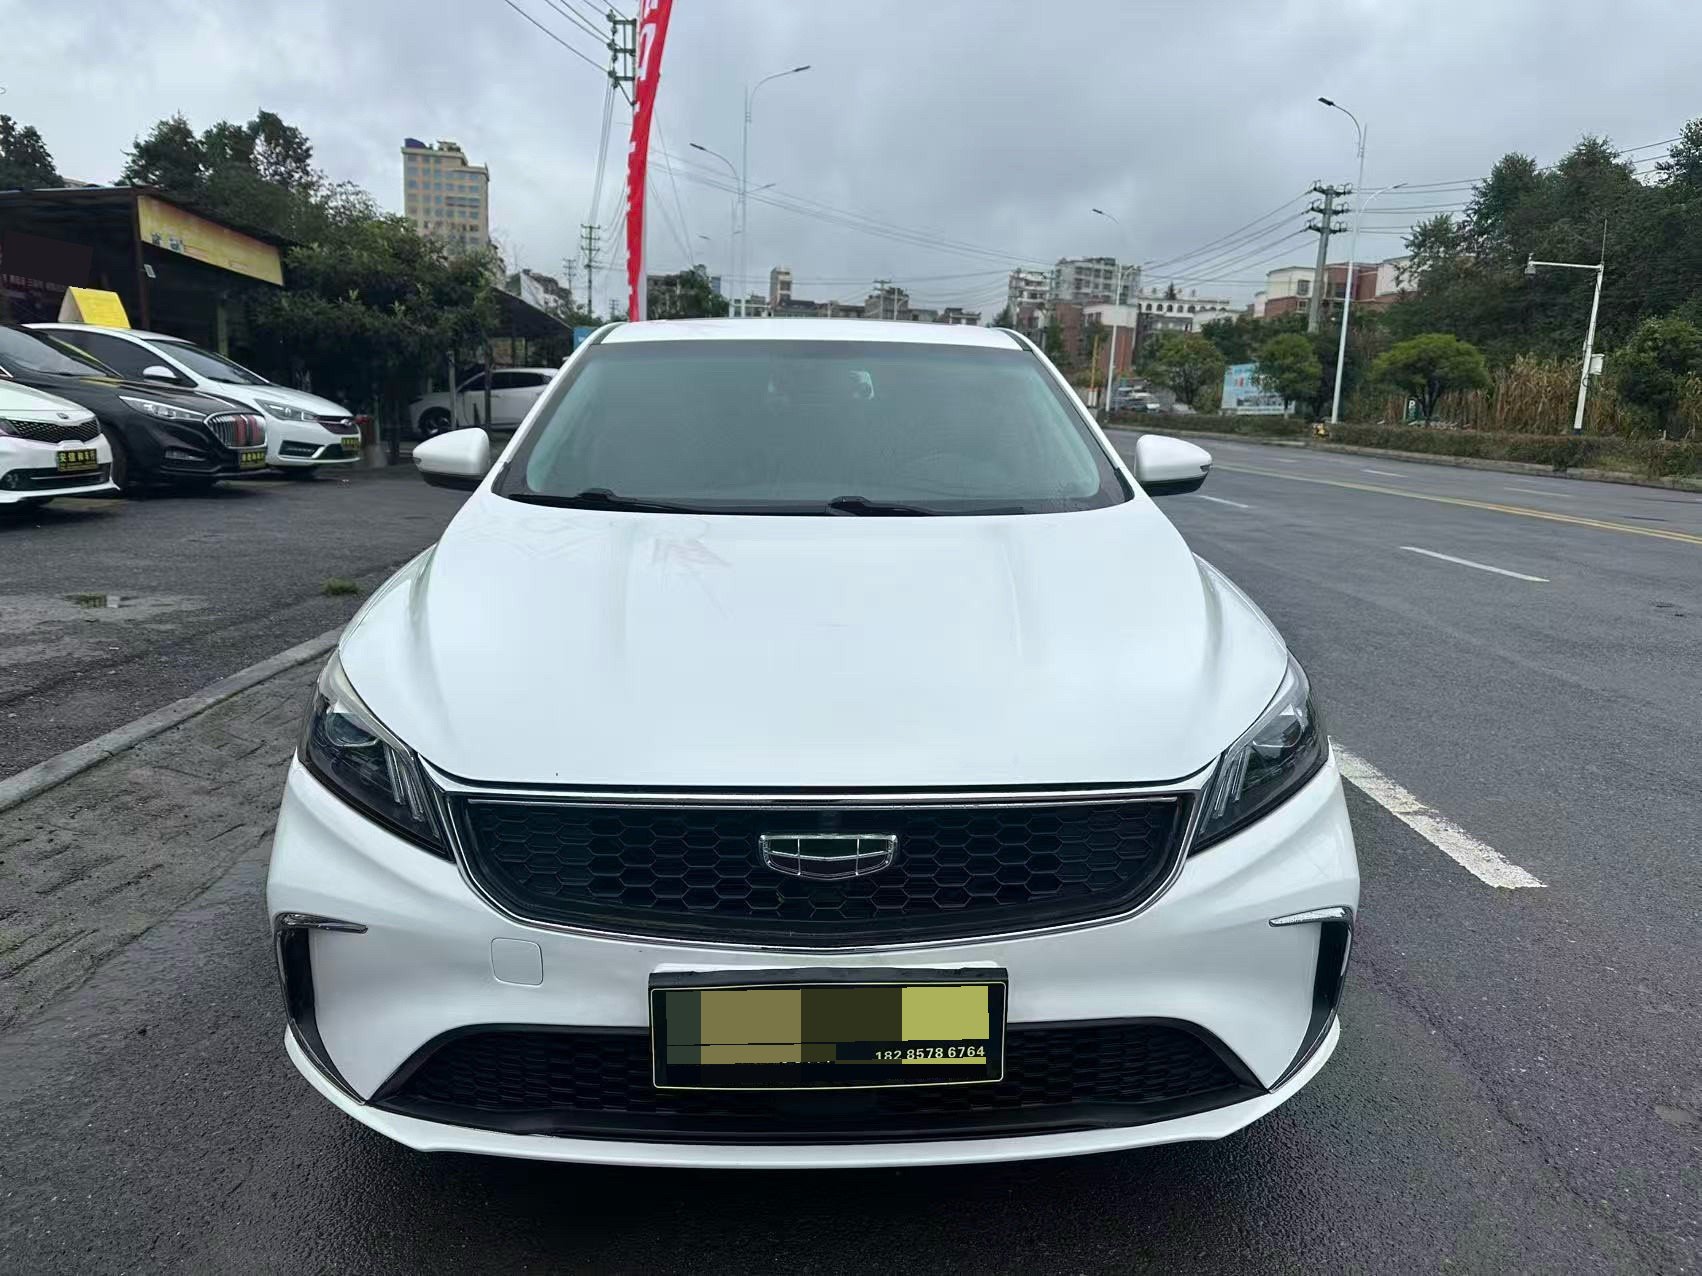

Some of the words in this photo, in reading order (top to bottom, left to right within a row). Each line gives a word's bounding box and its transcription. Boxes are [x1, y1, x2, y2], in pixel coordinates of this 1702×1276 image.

[1408, 400, 1416, 409] P
[875, 1050, 902, 1060] 182
[906, 1047, 944, 1060] 8578
[947, 1046, 985, 1058] 6764
